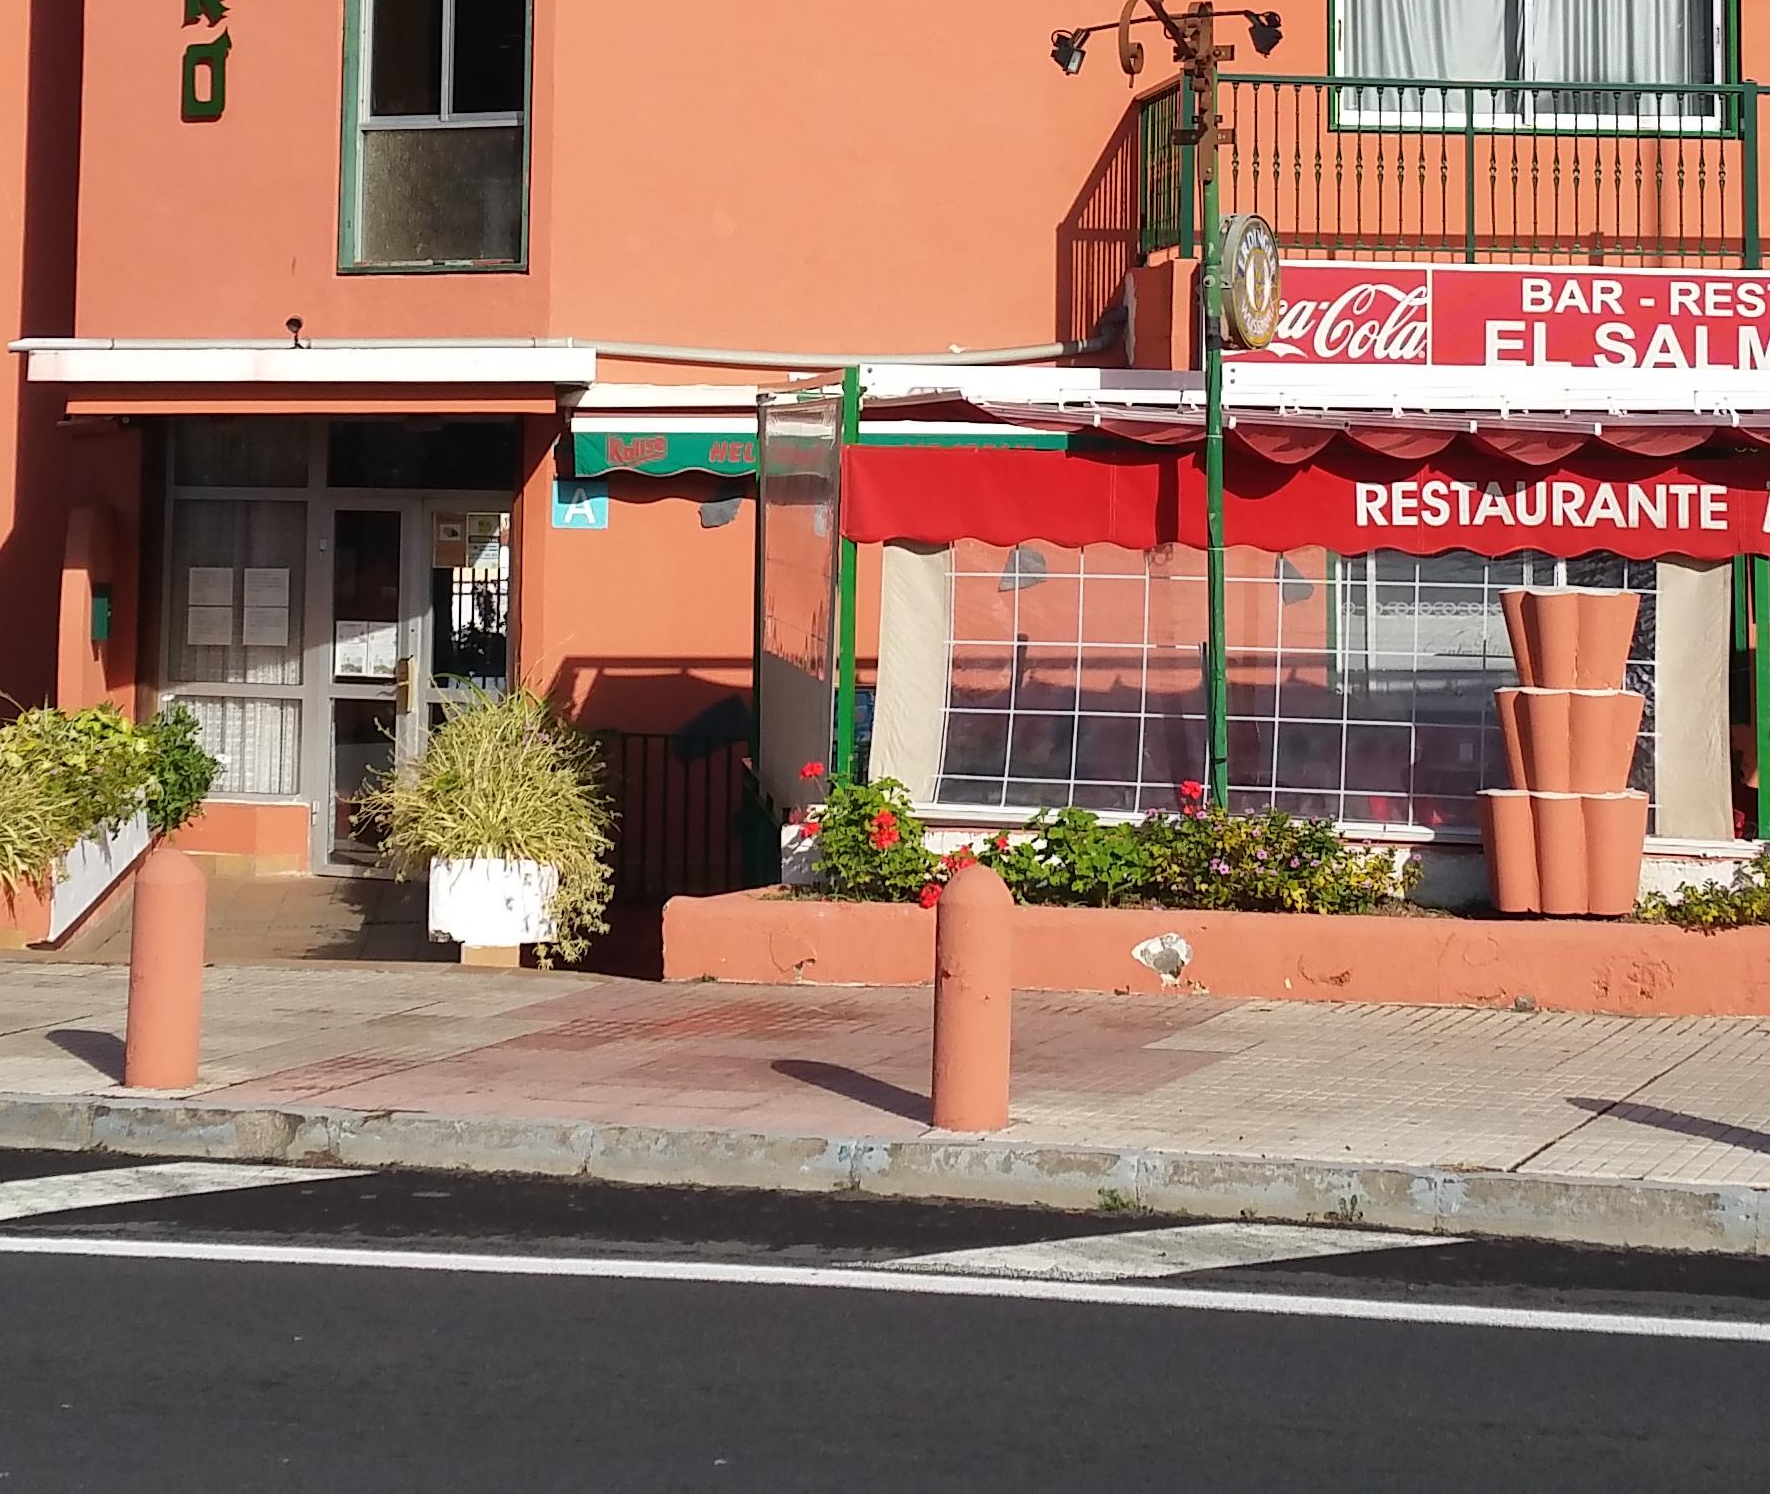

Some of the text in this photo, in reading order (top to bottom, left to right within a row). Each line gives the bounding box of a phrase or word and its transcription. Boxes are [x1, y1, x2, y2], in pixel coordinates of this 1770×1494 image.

[1521, 277, 1626, 315] BAR
[1485, 319, 1573, 367] EL
[564, 488, 597, 525] A
[1355, 480, 1729, 531] RESTAURANTE
